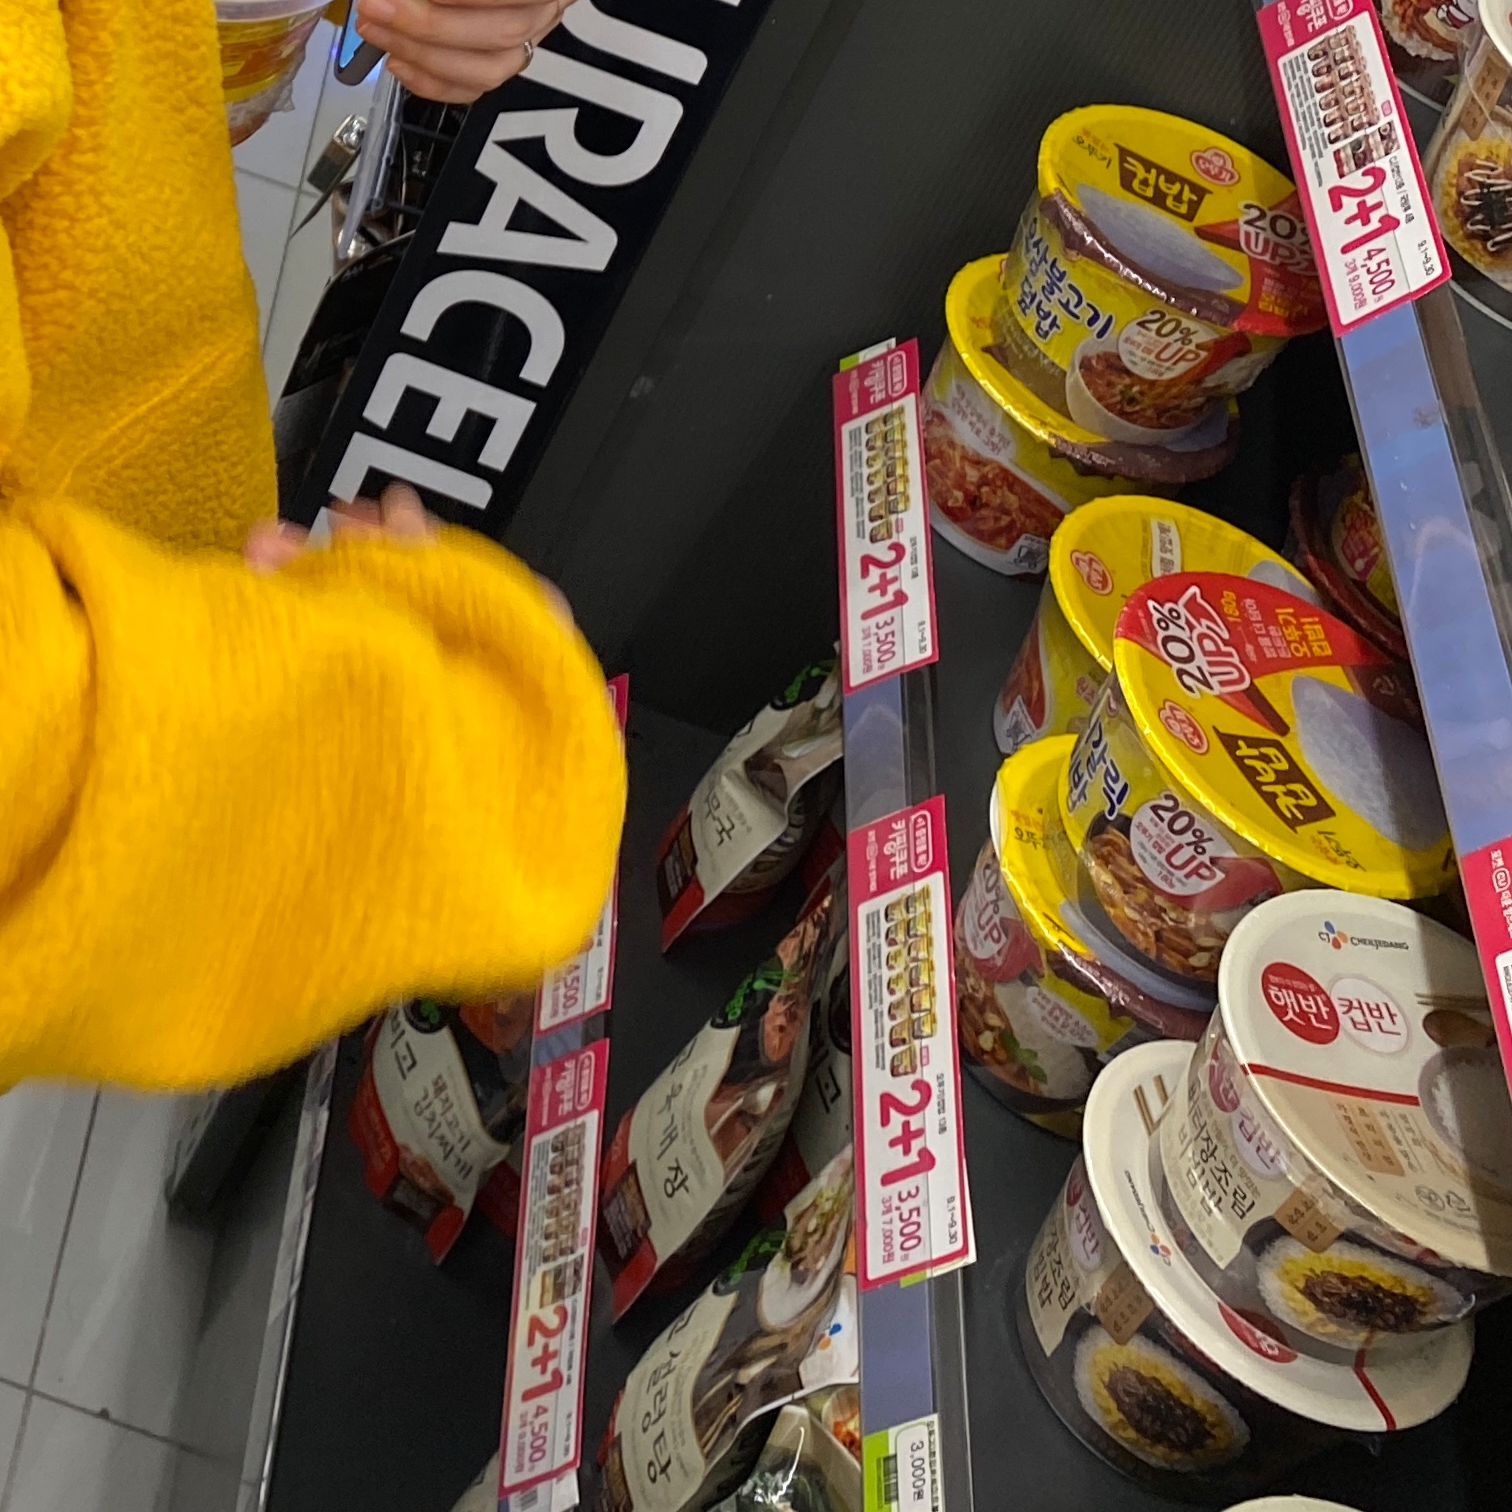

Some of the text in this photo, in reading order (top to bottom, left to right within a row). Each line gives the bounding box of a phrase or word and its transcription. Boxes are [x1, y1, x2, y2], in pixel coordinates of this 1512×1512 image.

[1328, 165, 1401, 255] 2+1
[1136, 309, 1201, 347] 20%
[1156, 343, 1201, 365] UP
[860, 541, 909, 621] 2+1
[1222, 590, 1241, 622] 180g
[1151, 601, 1215, 696] 20%
[1194, 625, 1248, 692] UP
[1275, 607, 1312, 659] 오뚜기
[1299, 616, 1334, 658] 컵밥!
[1150, 793, 1214, 855] 20%
[1164, 842, 1217, 882] UP
[1270, 986, 1334, 1031] 햇반
[1339, 996, 1402, 1037] 컵반
[413, 1089, 474, 1181] 김치찌개
[879, 1077, 938, 1188] 2+1
[1187, 1084, 1256, 1220] 버터장조림
[1238, 1105, 1284, 1171] 컵반
[880, 1195, 896, 1265] 3개 7,000원
[520, 1302, 568, 1402] 2+1
[641, 1349, 682, 1485] 설렁탕
[909, 1439, 927, 1502] 3,000원
